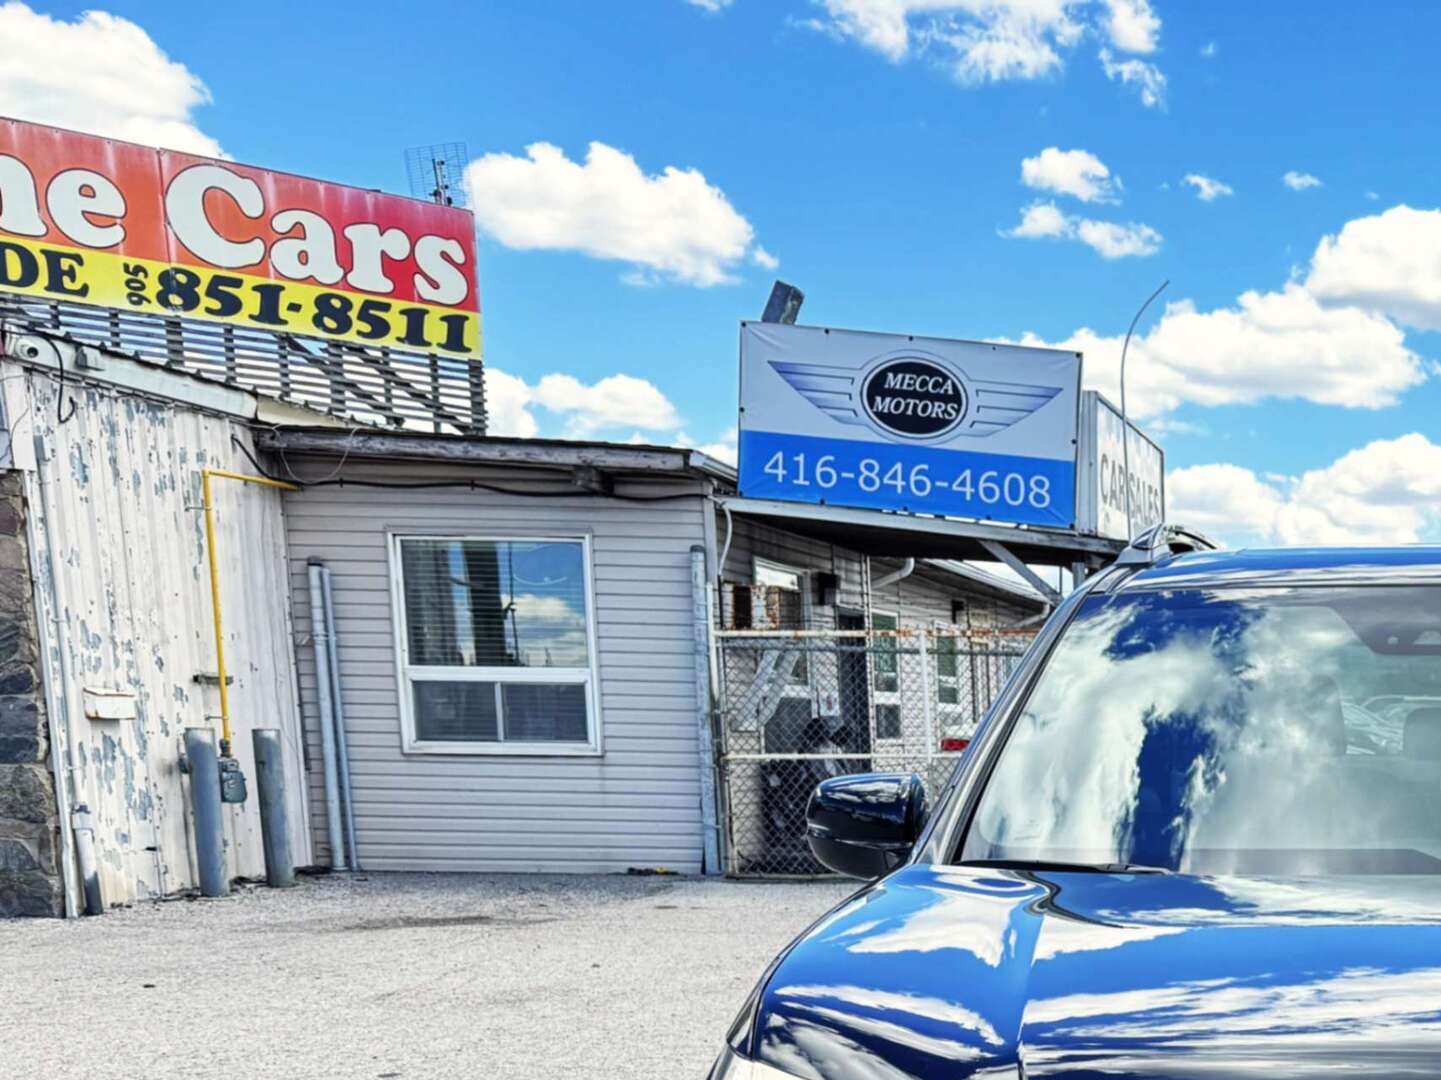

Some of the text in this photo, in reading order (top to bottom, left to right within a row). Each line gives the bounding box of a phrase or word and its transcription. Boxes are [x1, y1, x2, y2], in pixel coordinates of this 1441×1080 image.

[165, 163, 468, 305] Cars
[123, 263, 151, 306] 905
[156, 267, 473, 353] 851-8511
[872, 395, 958, 420] MOTORS
[884, 372, 954, 395] MECCA
[764, 451, 1050, 509] 416-846-4608
